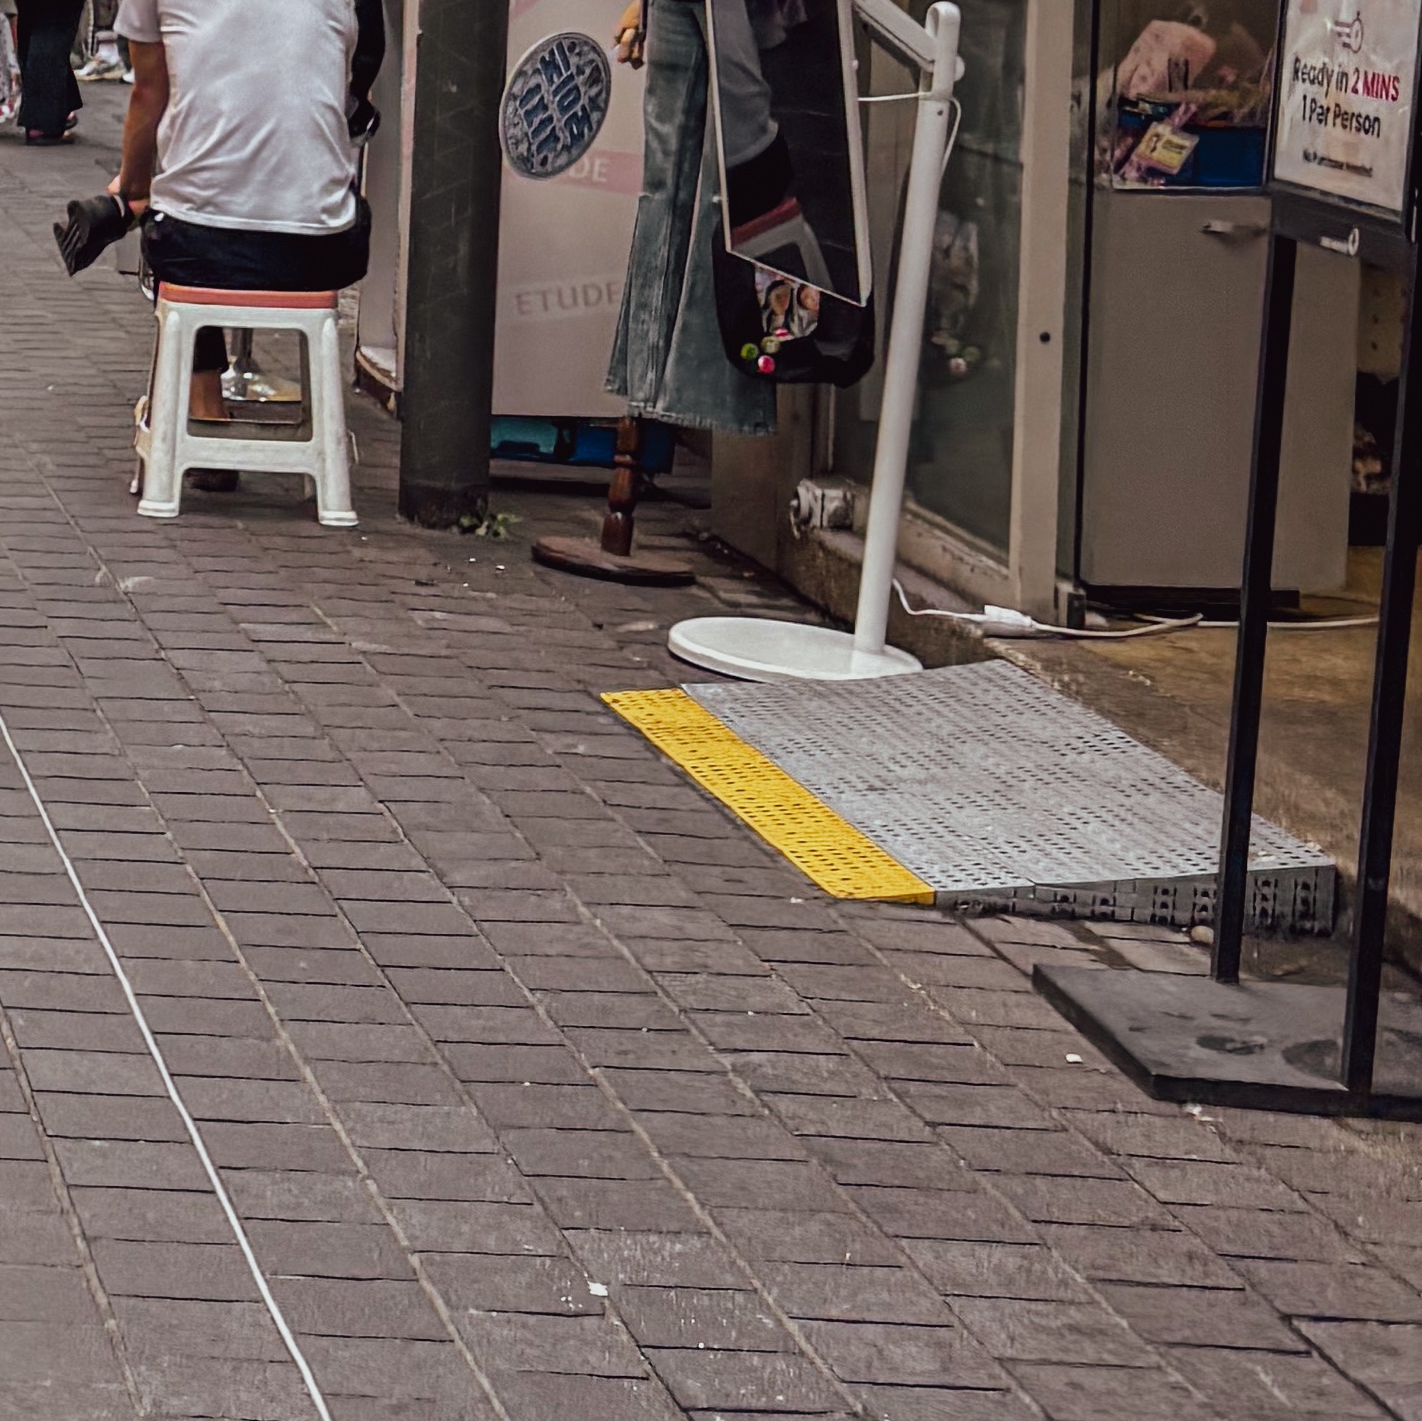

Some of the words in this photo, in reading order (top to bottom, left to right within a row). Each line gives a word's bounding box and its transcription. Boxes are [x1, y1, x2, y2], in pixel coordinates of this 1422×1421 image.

[1293, 56, 1334, 98] Ready
[1336, 64, 1348, 93] in
[1351, 67, 1360, 94] 2
[1363, 70, 1400, 101] MINS
[1302, 94, 1308, 121] 1
[1309, 98, 1330, 127] Per
[1332, 103, 1381, 138] Person
